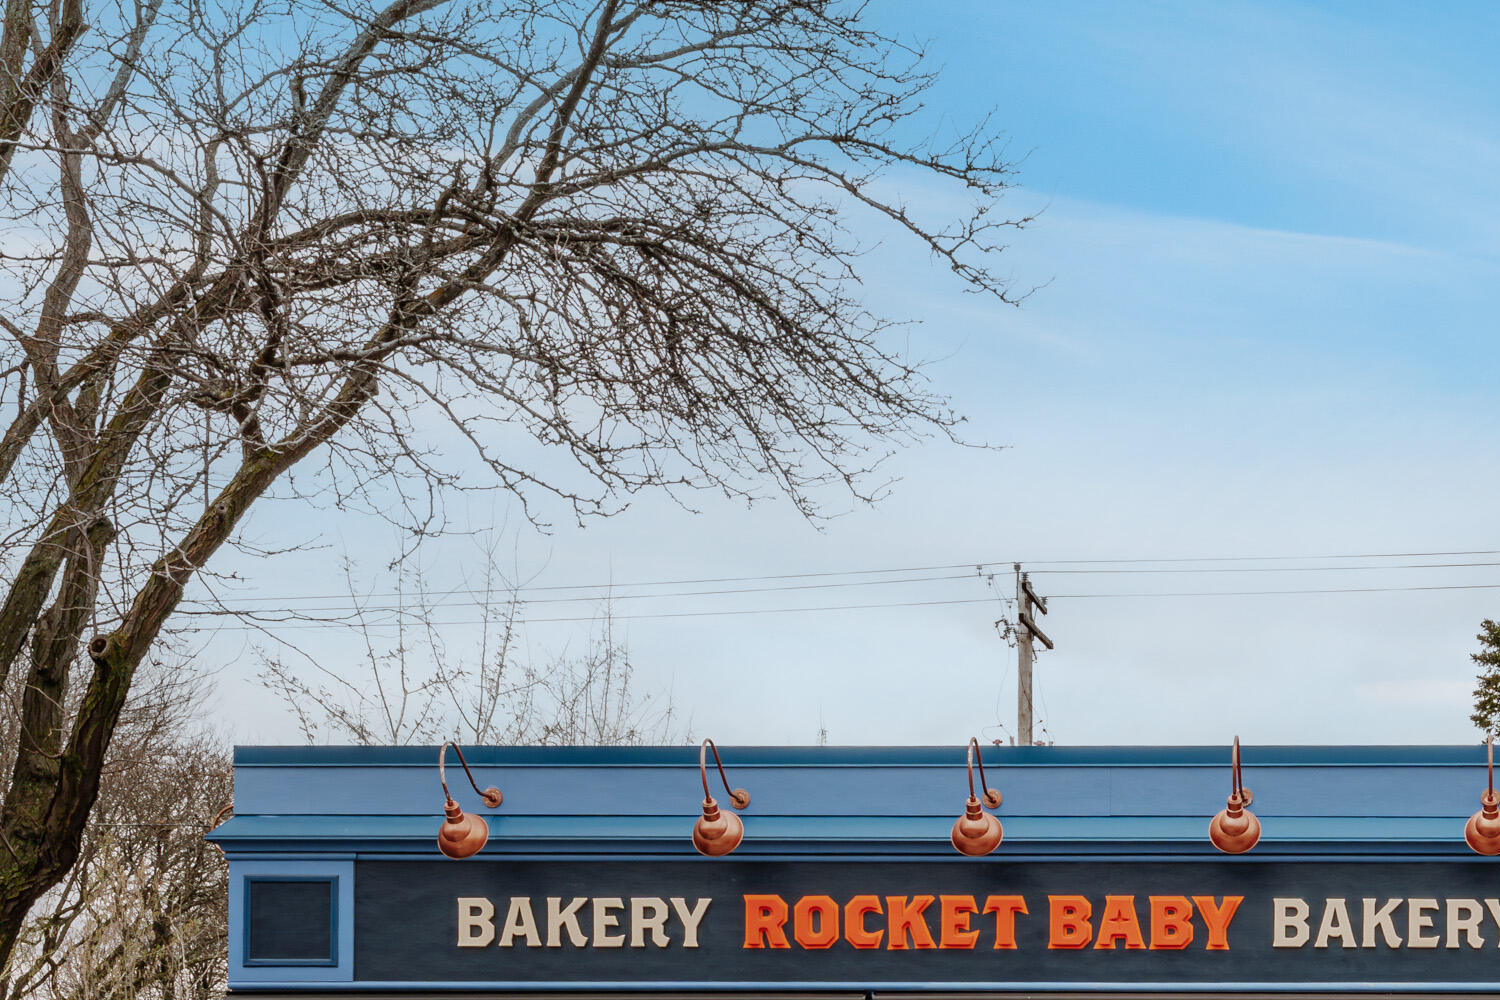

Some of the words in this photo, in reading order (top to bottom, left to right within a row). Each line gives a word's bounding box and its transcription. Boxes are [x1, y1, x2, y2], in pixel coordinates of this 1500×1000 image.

[457, 897, 712, 948] BAKERY
[743, 894, 1029, 950] ROCKET
[1047, 895, 1244, 950] BABY
